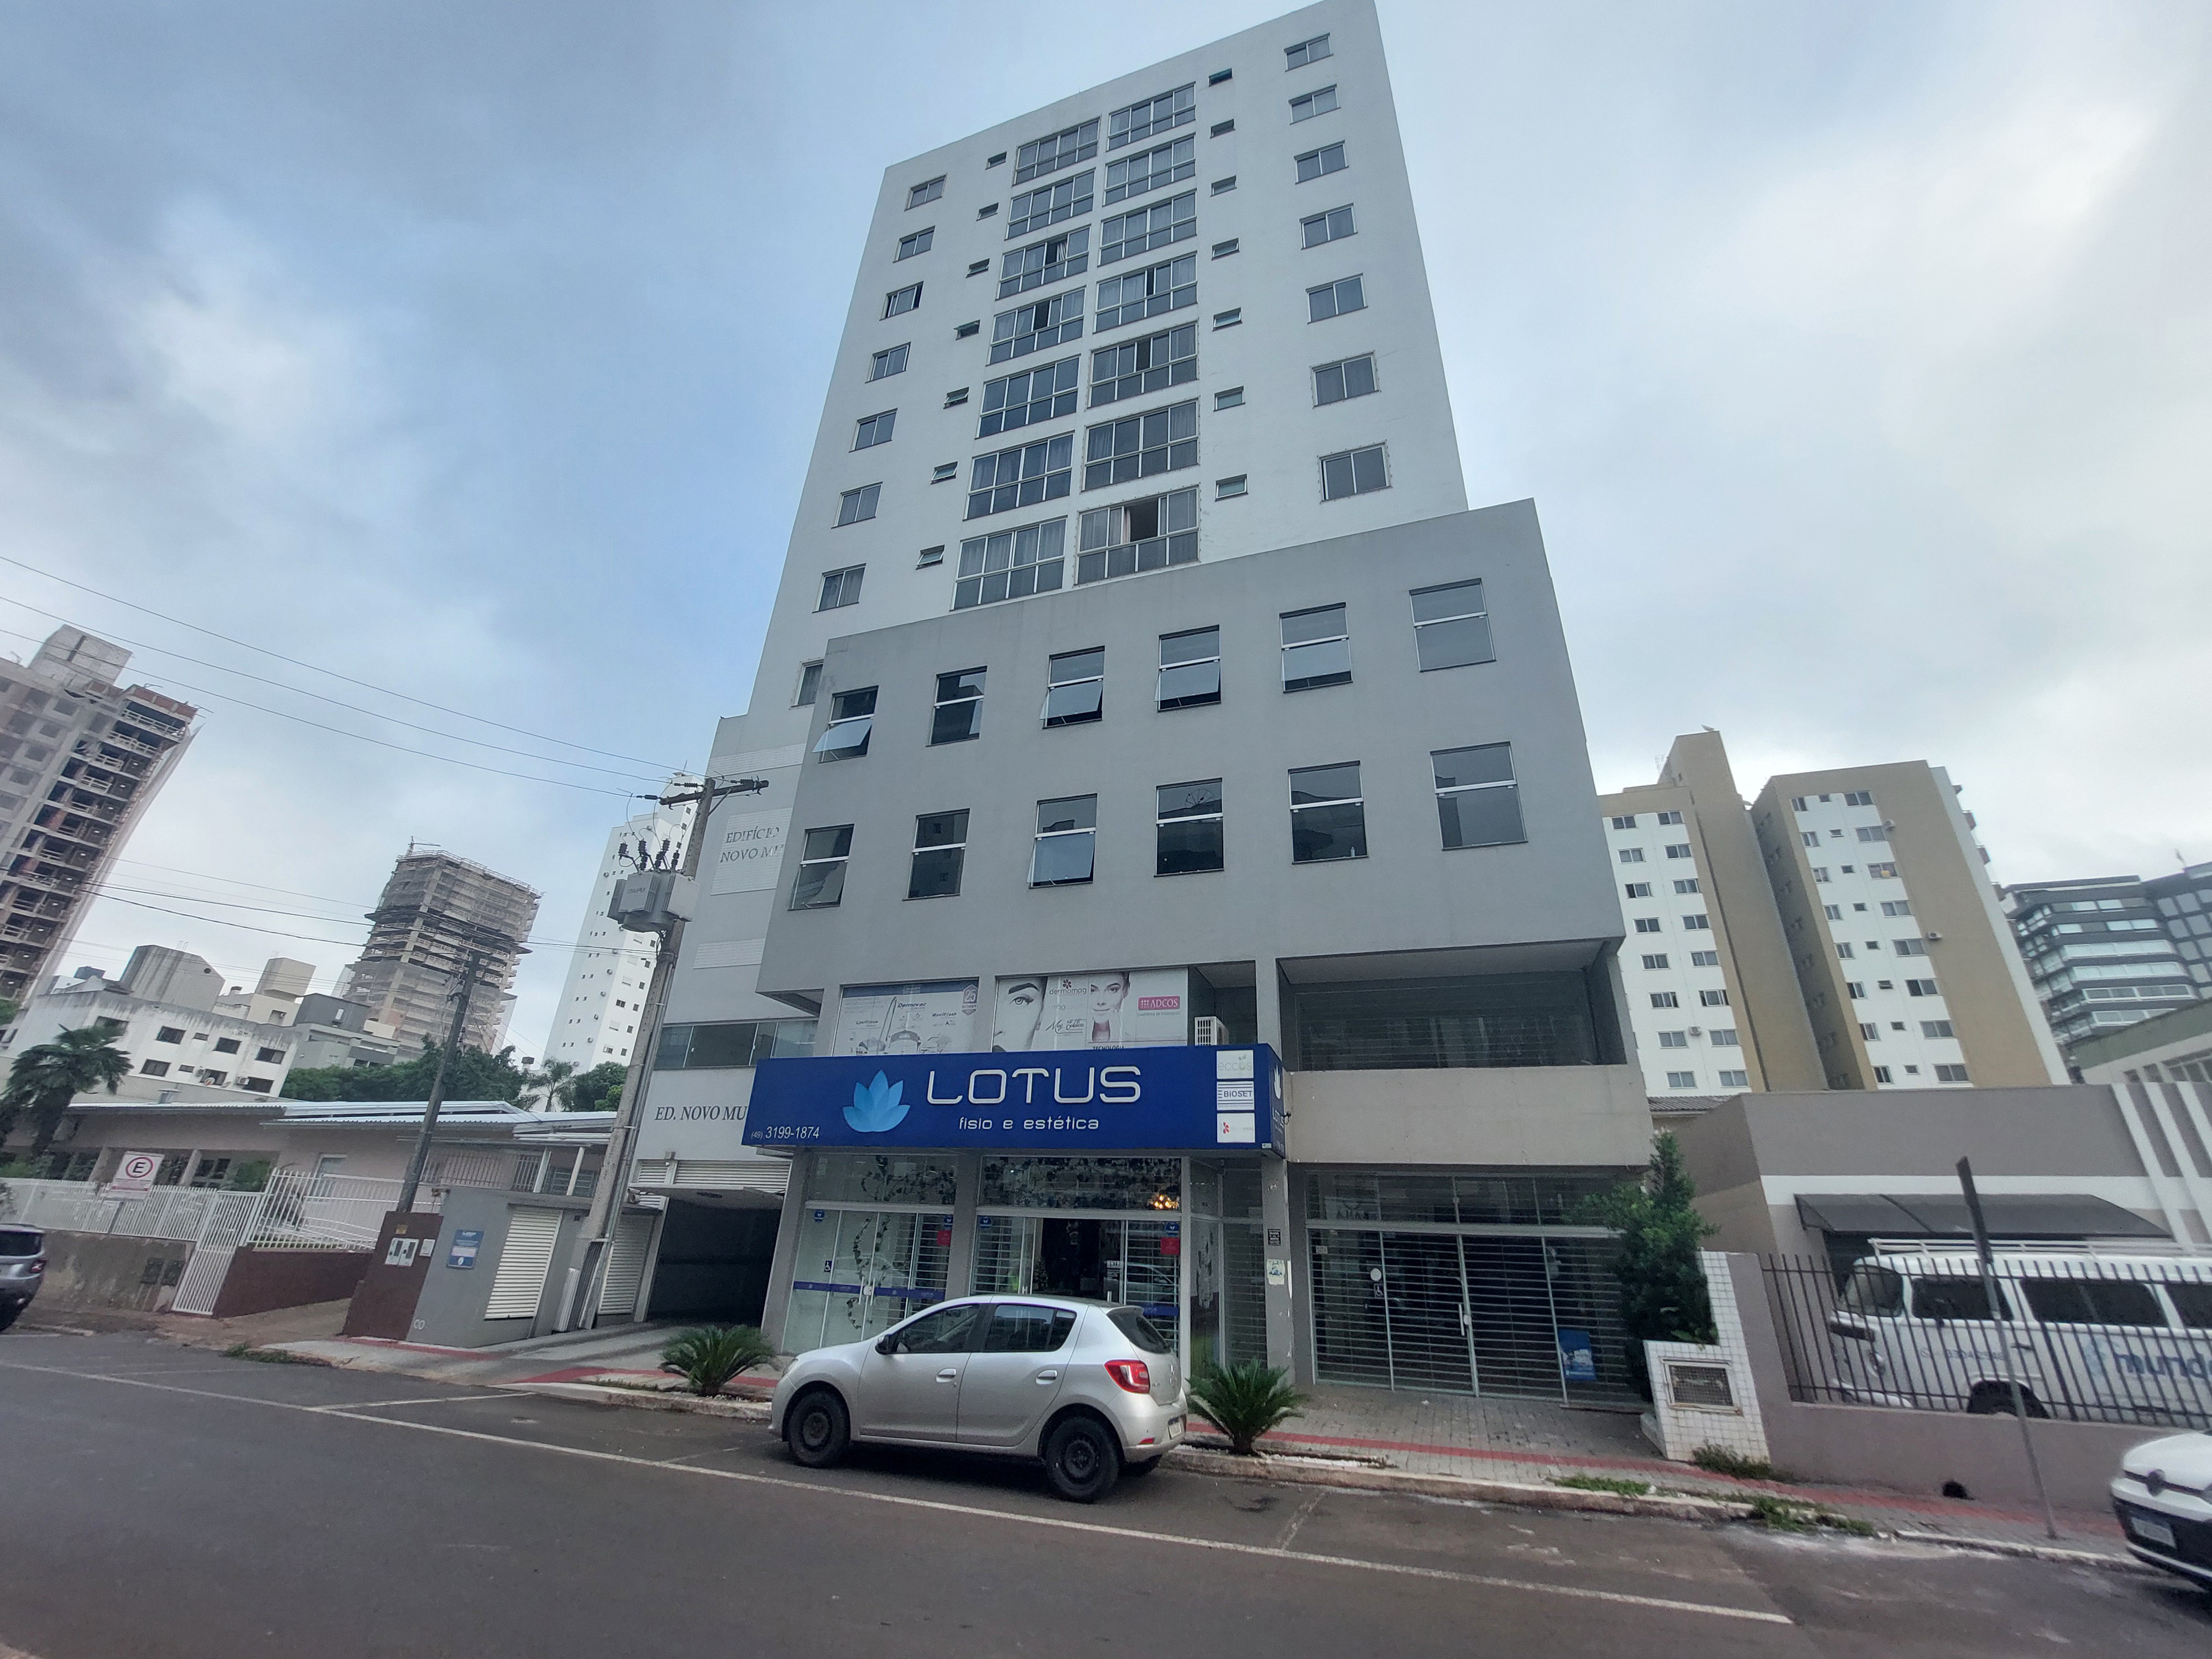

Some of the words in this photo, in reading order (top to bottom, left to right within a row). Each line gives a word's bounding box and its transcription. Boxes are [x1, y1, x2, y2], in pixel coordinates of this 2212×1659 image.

[726, 825, 779, 843] EDIFÍCIO
[720, 848, 758, 863] NOVO
[964, 989, 977, 1003] 25
[1150, 998, 1178, 1008] ADCOS
[926, 1065, 1141, 1104] LOTUS
[654, 1107, 676, 1120] ED.
[680, 1105, 720, 1121] NOVO
[959, 1116, 993, 1130] fisio
[1003, 1118, 1013, 1129] e
[1024, 1115, 1099, 1130] estética
[751, 1130, 763, 1140] (49)
[765, 1125, 820, 1140] 3199-1874
[133, 1162, 147, 1173] E
